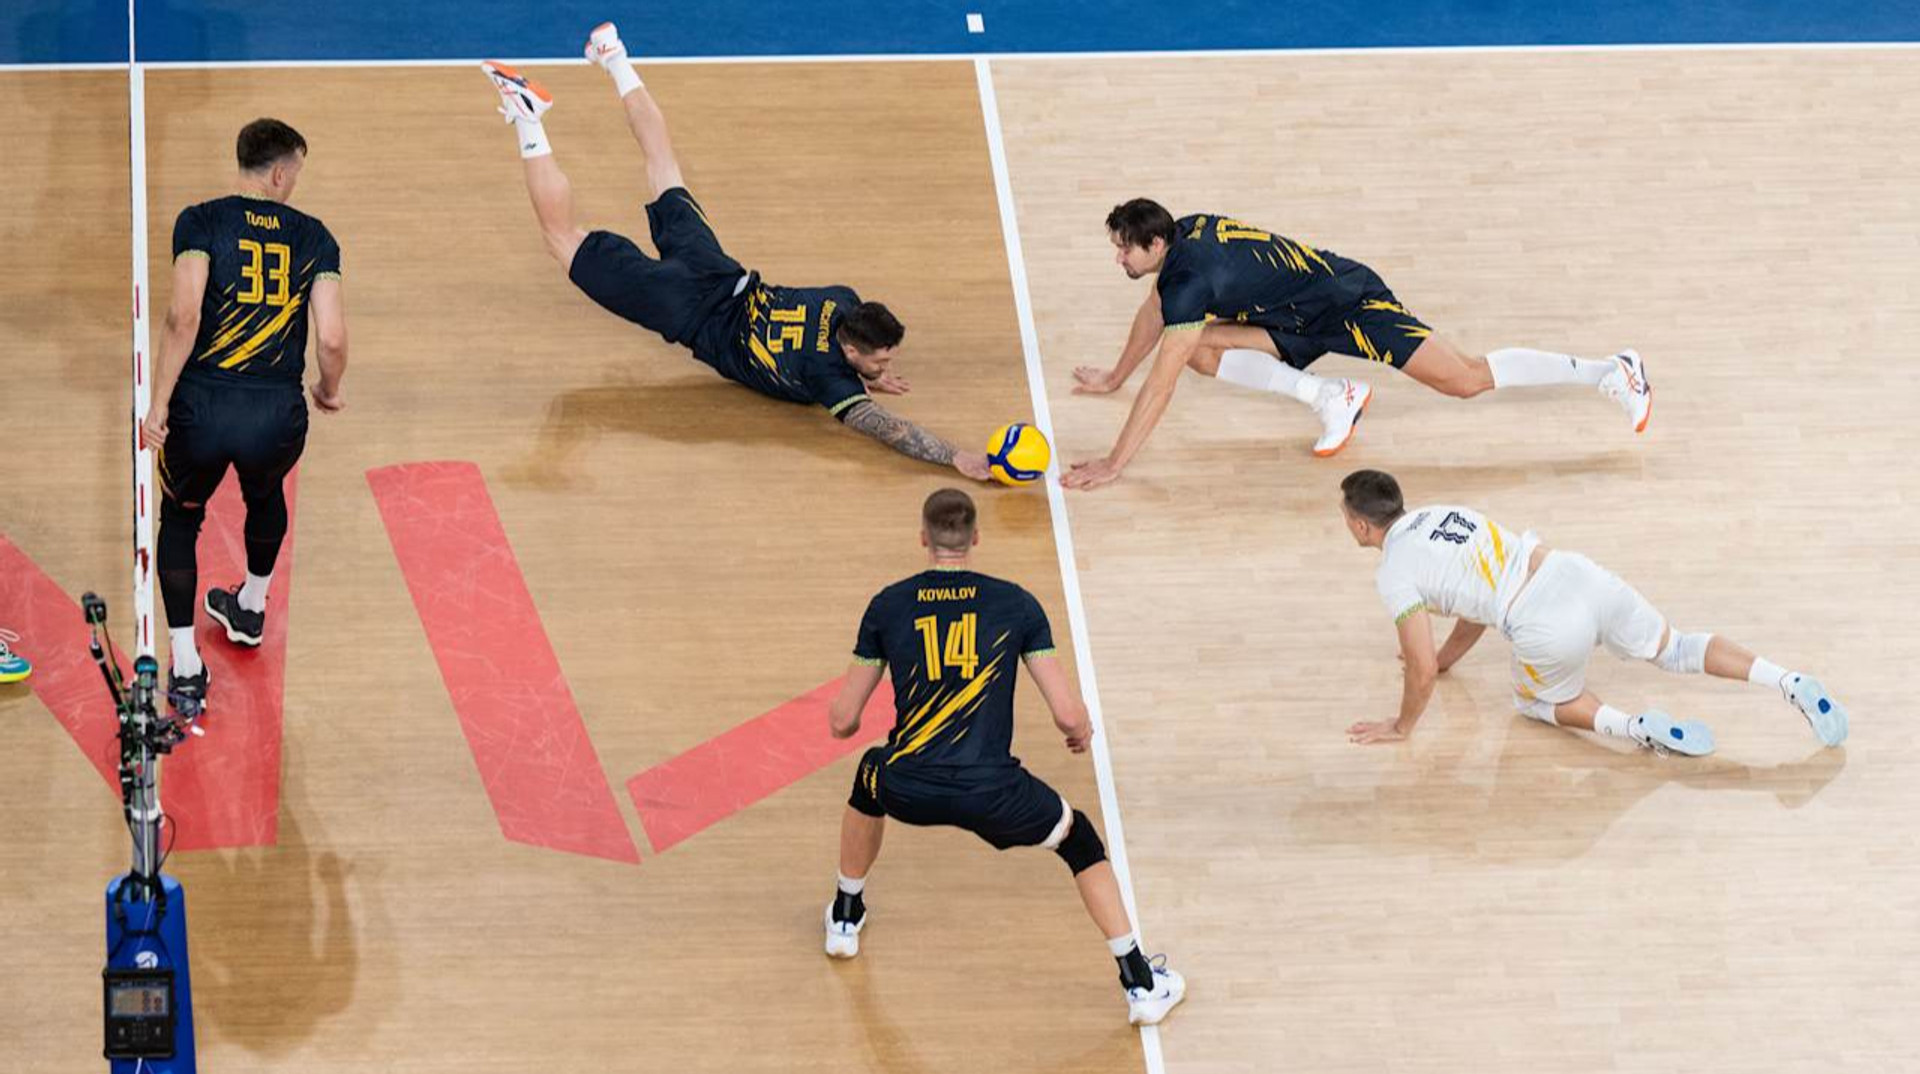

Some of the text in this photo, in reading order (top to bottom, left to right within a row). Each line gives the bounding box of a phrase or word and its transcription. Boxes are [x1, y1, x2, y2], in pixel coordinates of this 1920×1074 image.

[232, 239, 291, 307] 33
[767, 304, 806, 353] 15
[917, 586, 977, 602] KOVALOV
[914, 612, 979, 682] 14
